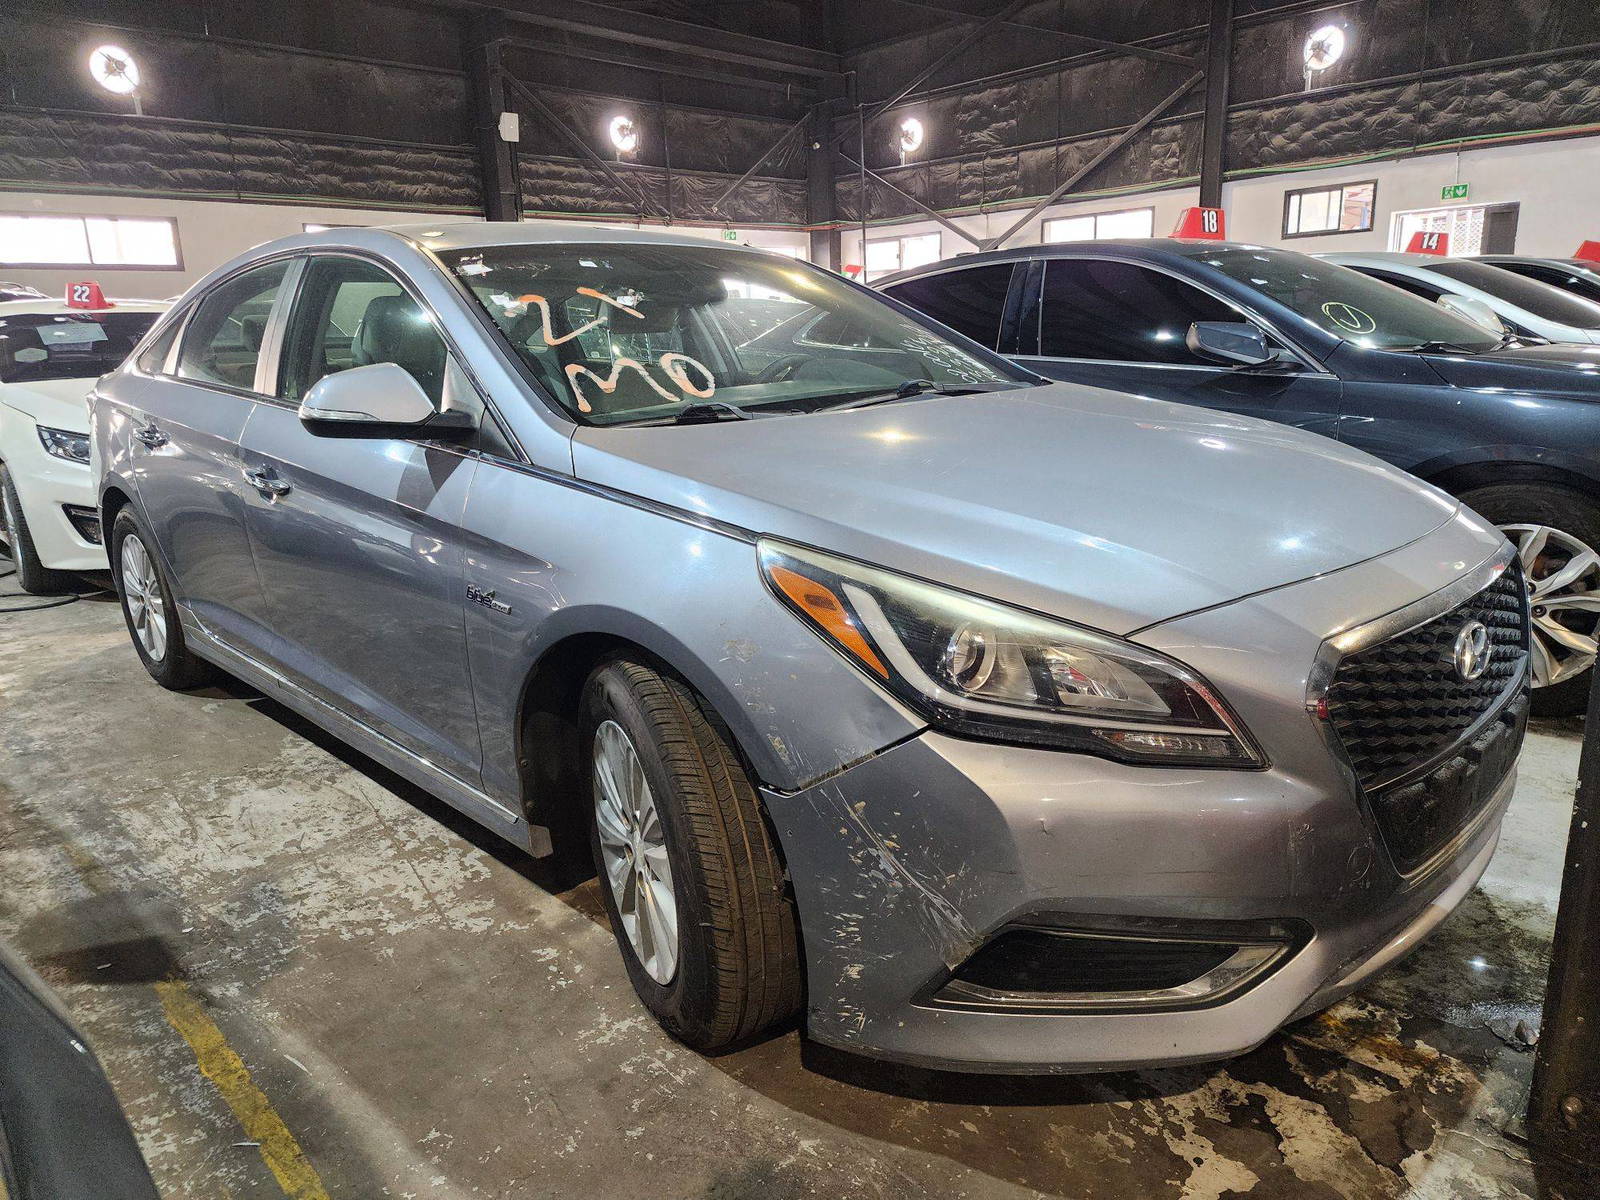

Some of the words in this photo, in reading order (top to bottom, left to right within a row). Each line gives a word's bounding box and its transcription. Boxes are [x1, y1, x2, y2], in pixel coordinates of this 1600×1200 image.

[1202, 210, 1217, 233] 18
[1423, 232, 1438, 249] 14
[73, 285, 90, 303] 22
